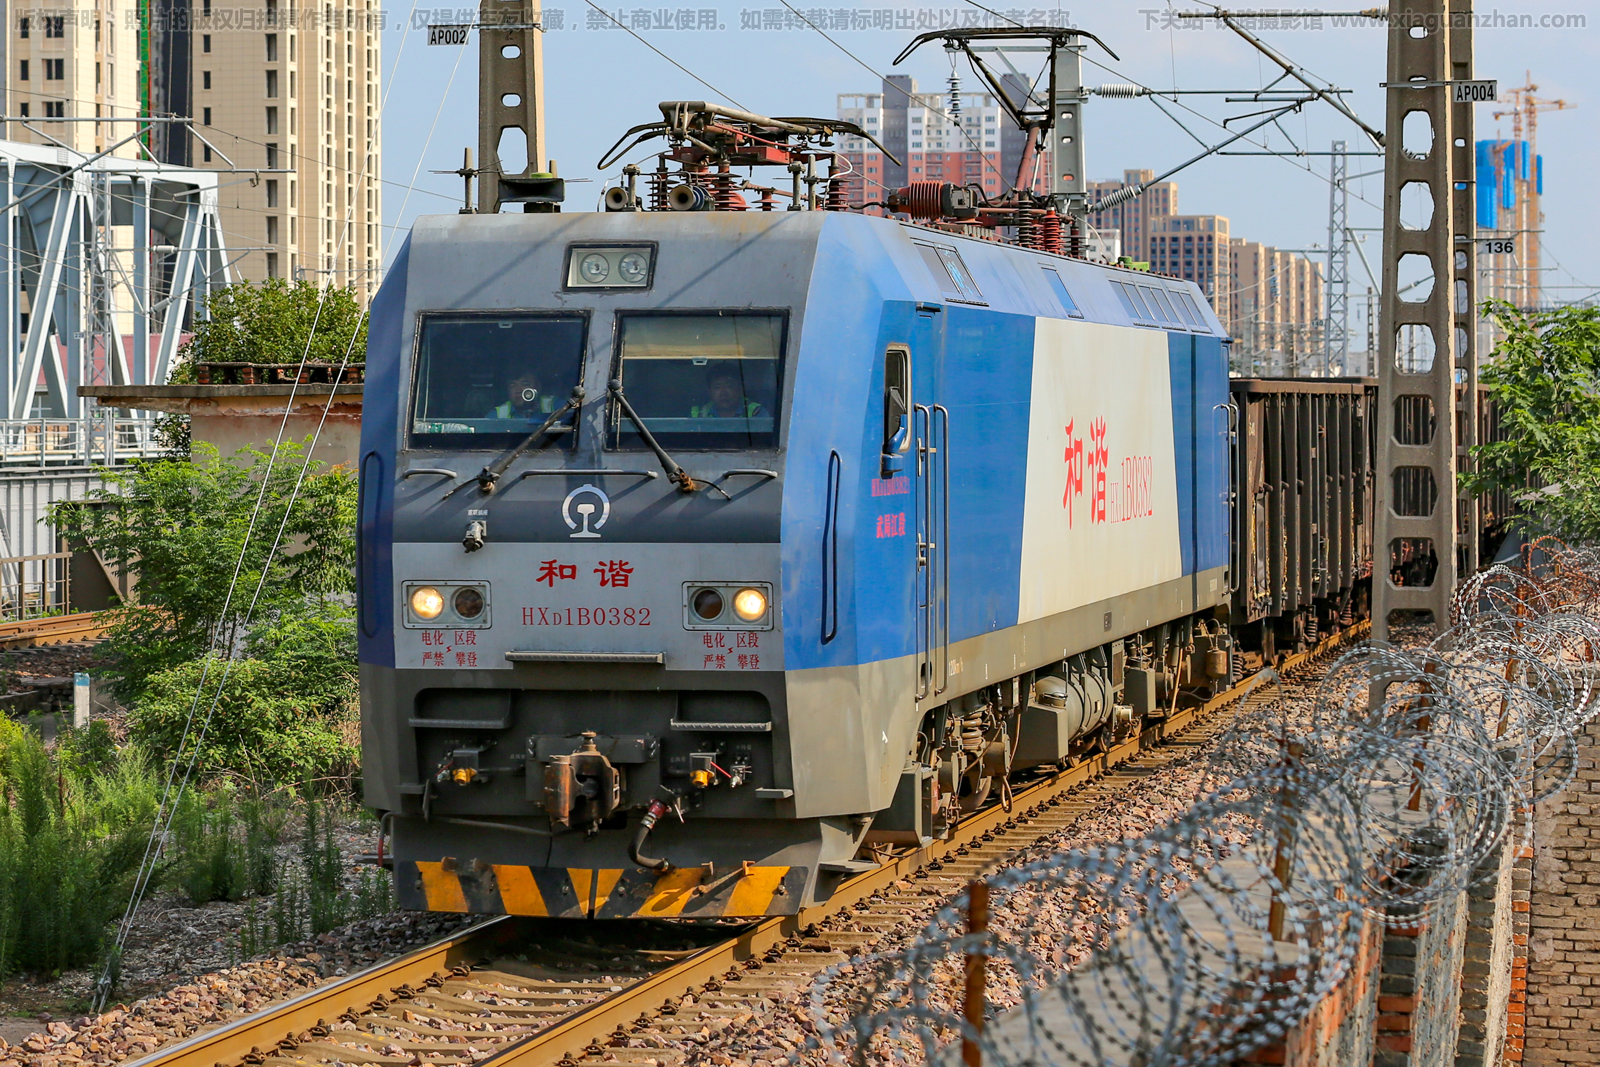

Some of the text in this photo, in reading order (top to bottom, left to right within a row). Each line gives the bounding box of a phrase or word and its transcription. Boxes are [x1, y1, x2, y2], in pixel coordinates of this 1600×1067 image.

[430, 29, 467, 45] AP002
[1456, 84, 1495, 101] AP004
[1485, 241, 1514, 254] 136
[1063, 414, 1109, 530] 和谐
[535, 559, 635, 588] 和谐
[521, 606, 652, 627] HXD1B0382
[421, 629, 477, 646] 电化 区段
[702, 632, 760, 649] 电化 区段
[421, 651, 478, 668] 严禁 攀登
[703, 653, 760, 670] 严禁 攀登
